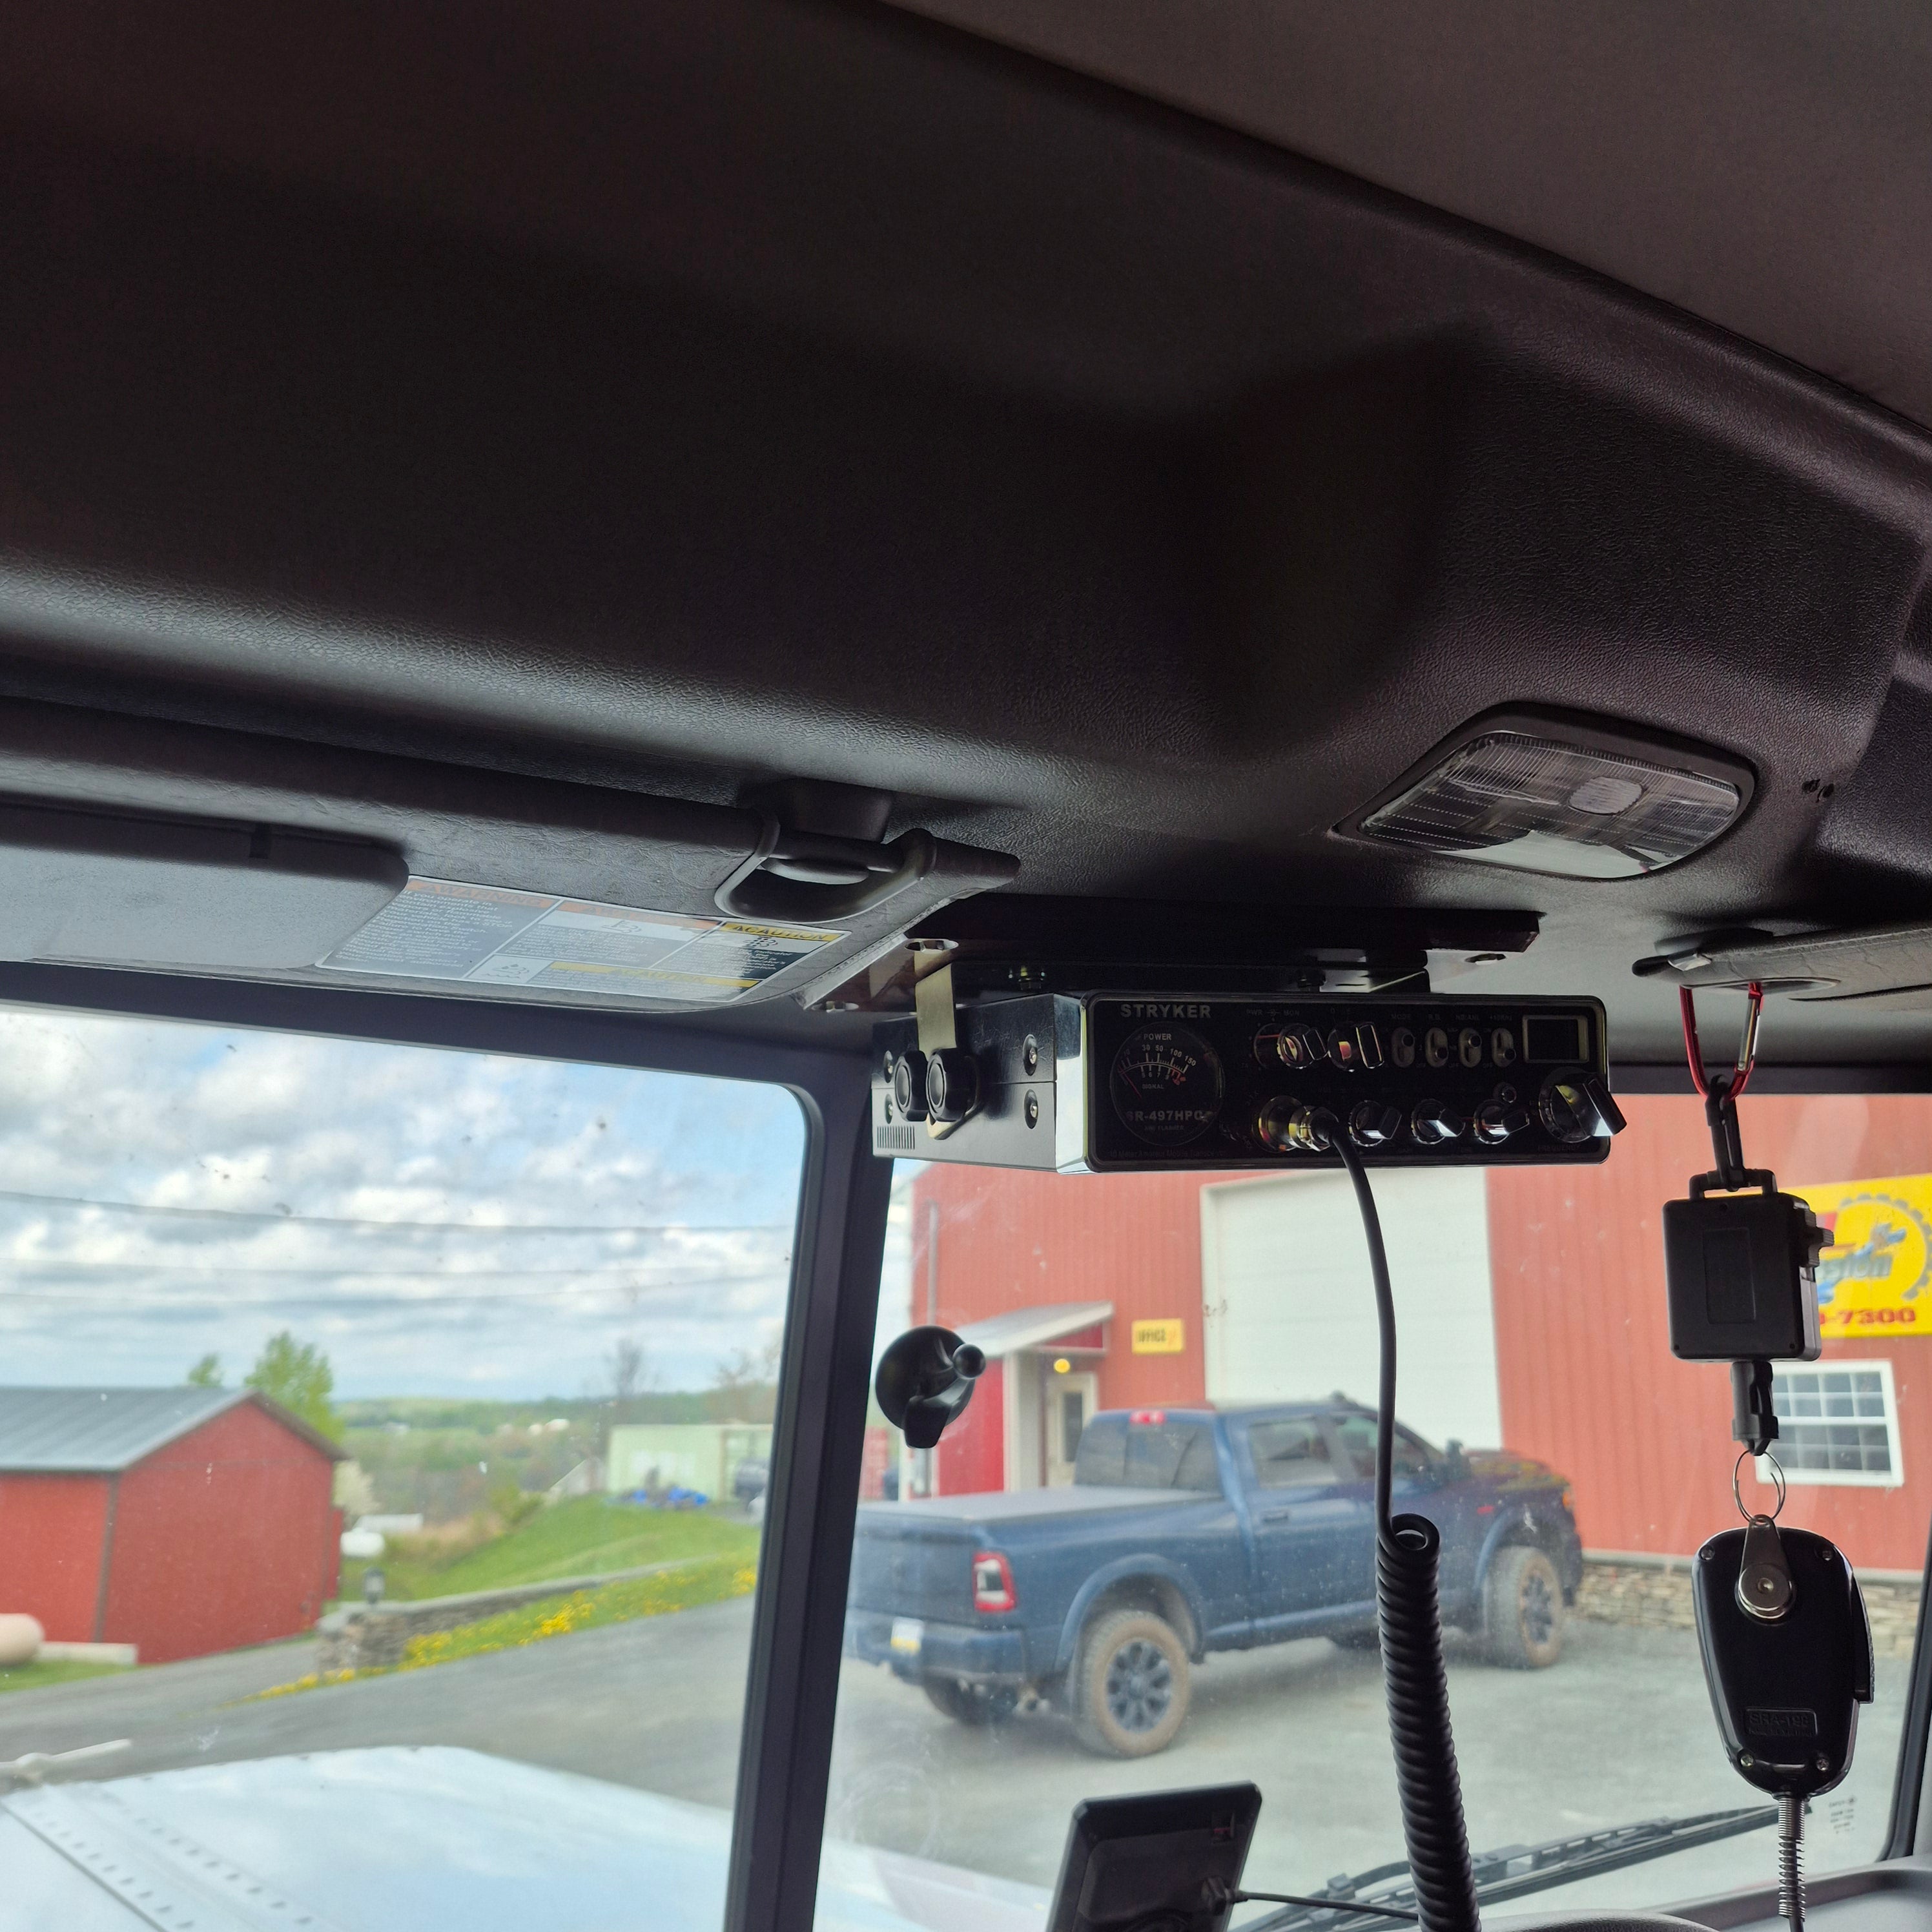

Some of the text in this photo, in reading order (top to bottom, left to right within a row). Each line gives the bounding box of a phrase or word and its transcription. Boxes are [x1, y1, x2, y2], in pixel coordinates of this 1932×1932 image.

[435, 895, 480, 905] operate
[437, 884, 544, 907] WARNING
[740, 926, 832, 939] CAUTION
[1120, 1004, 1211, 1018] STRYKER
[1170, 1048, 1182, 1058] 100
[1184, 1055, 1197, 1066] 150
